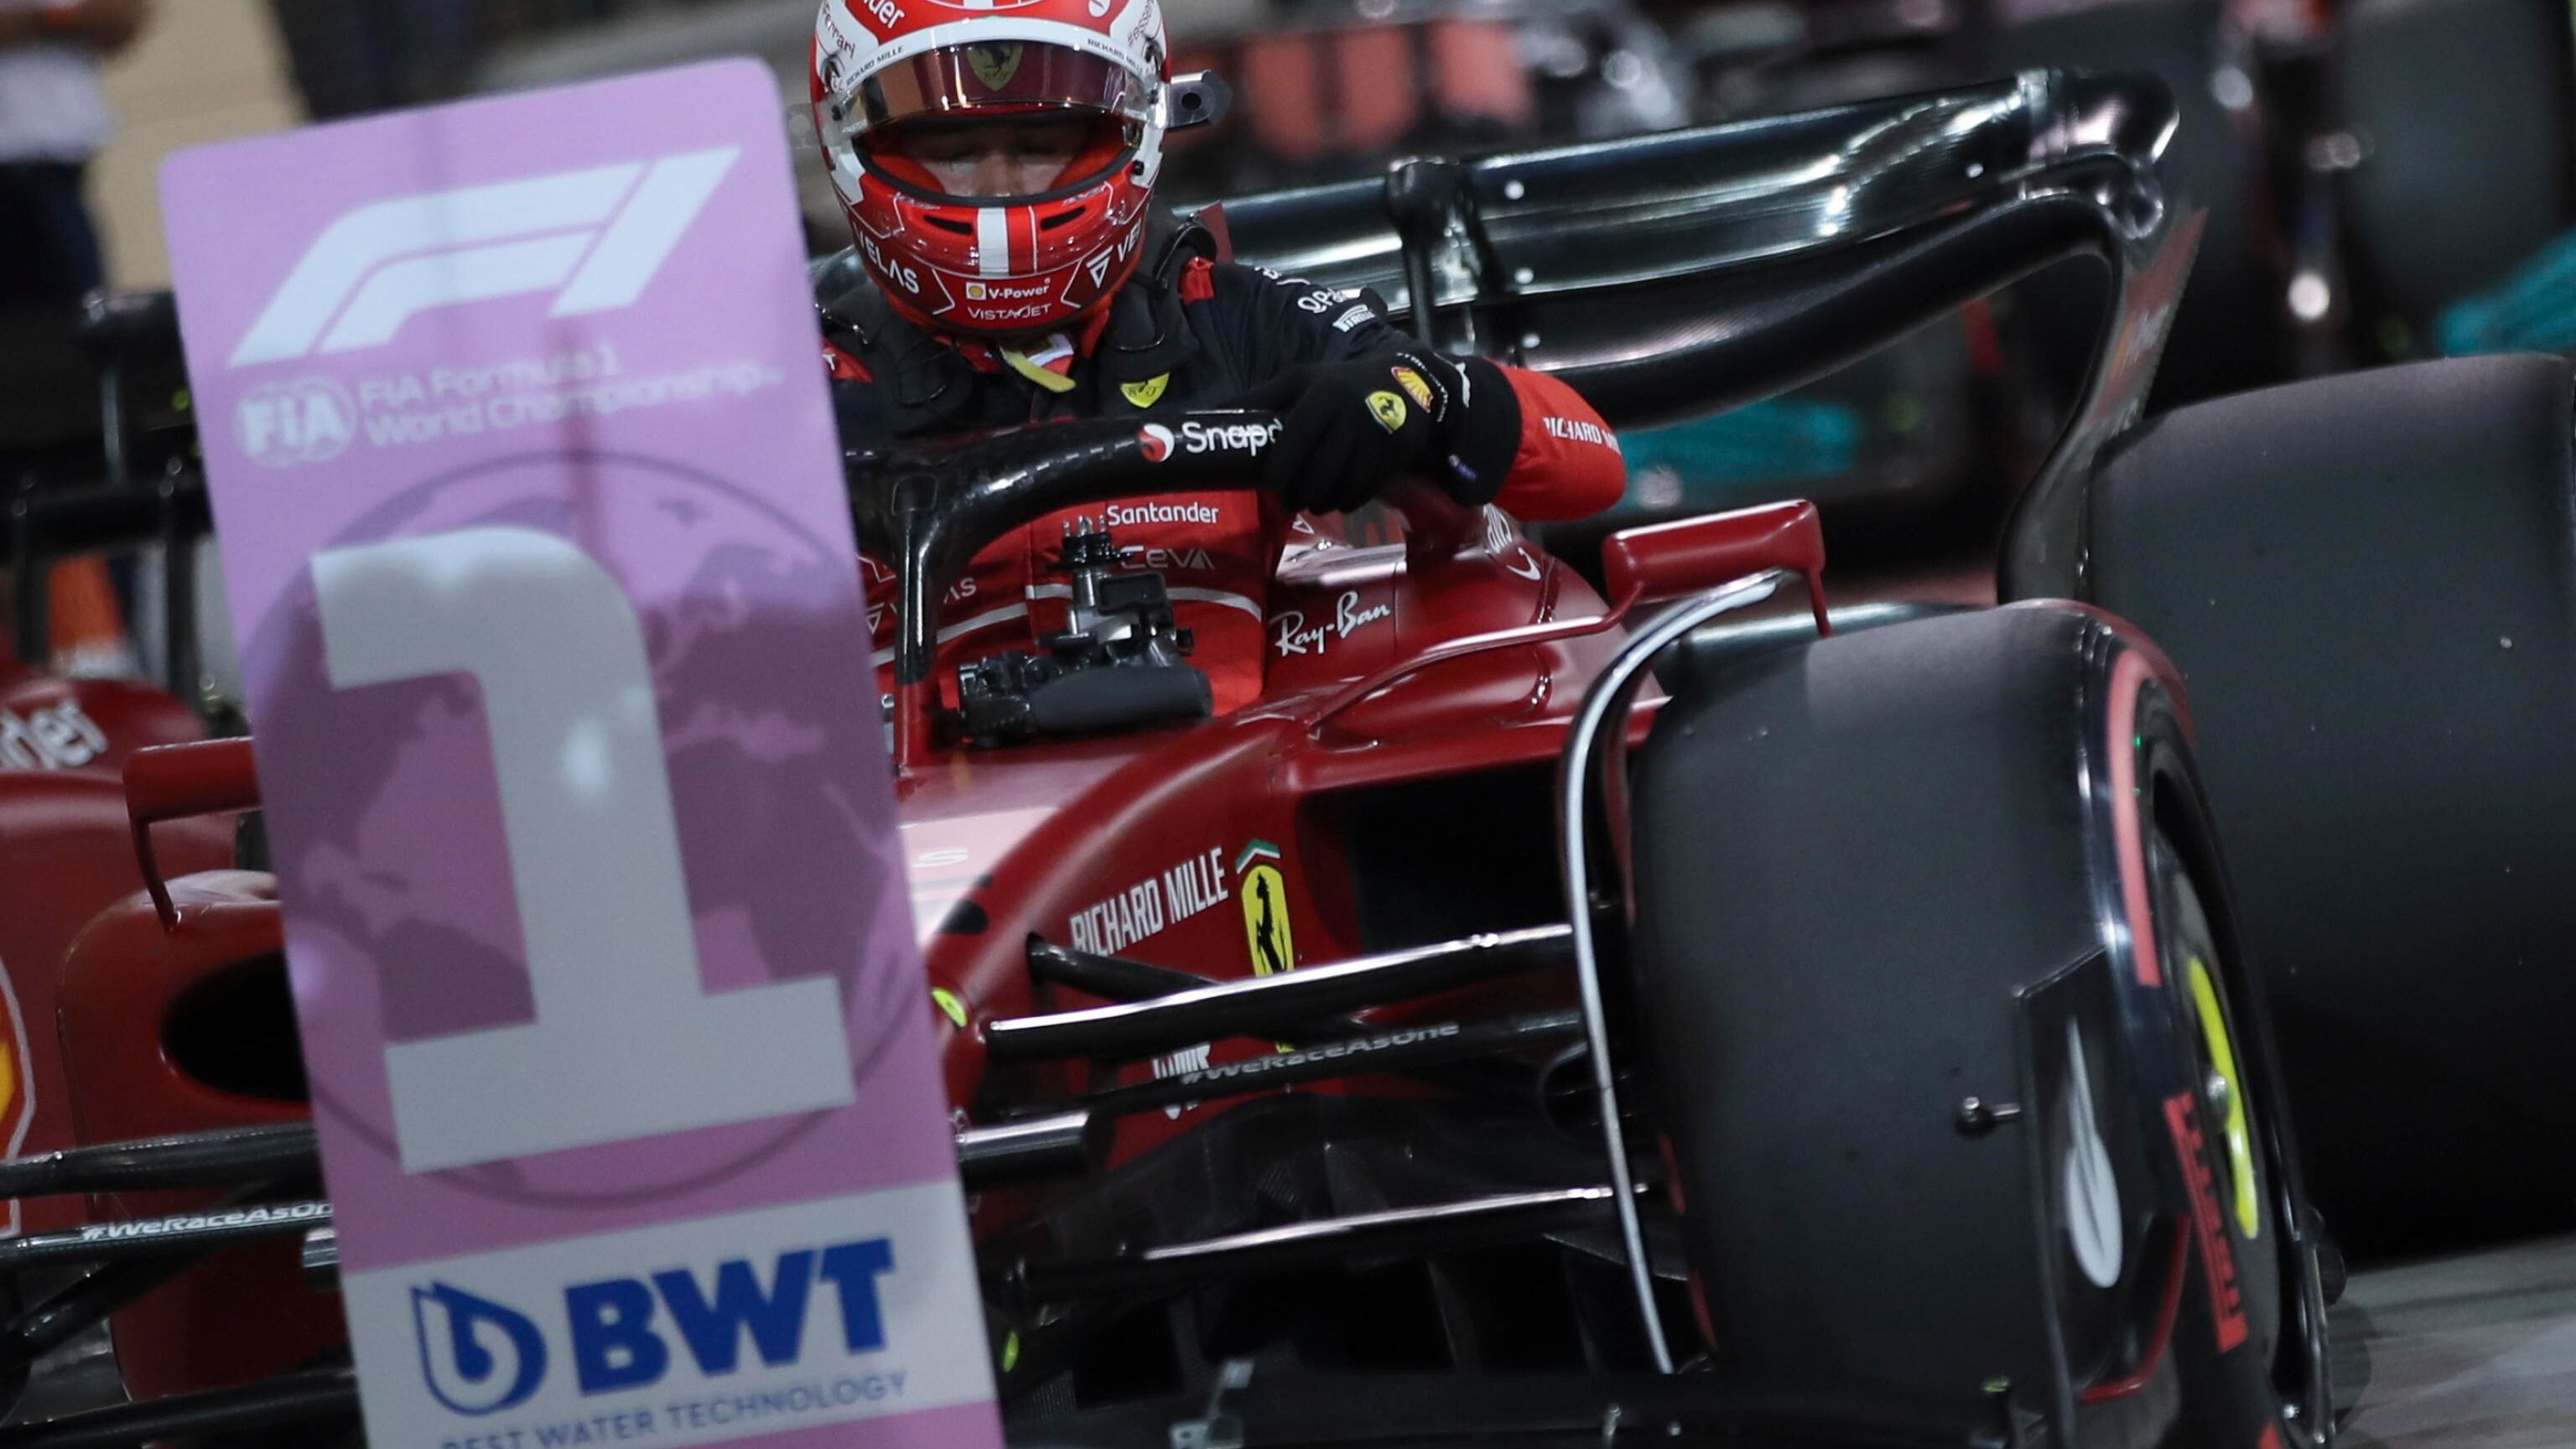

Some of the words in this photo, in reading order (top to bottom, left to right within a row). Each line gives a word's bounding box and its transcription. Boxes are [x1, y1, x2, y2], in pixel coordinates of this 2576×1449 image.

[876, 44, 904, 63] MILLE
[228, 144, 741, 367] F1
[988, 285, 1049, 300] V-Power
[241, 389, 348, 455] FIA
[359, 376, 425, 409] FIA
[365, 397, 483, 447] World
[1106, 501, 1219, 527] Santander
[1269, 590, 1391, 657] Ray-Ban
[310, 526, 856, 1174] 1
[1070, 878, 1164, 957] RICHARD
[1164, 846, 1228, 924] MILLE
[1181, 1021, 1460, 1085] #WeRaceAsOne
[82, 1202, 333, 1241] #WeRaceAsOn
[564, 1237, 896, 1397] BWT
[534, 1410, 656, 1447] WATER
[665, 1369, 909, 1428] TECHNOLOGY
